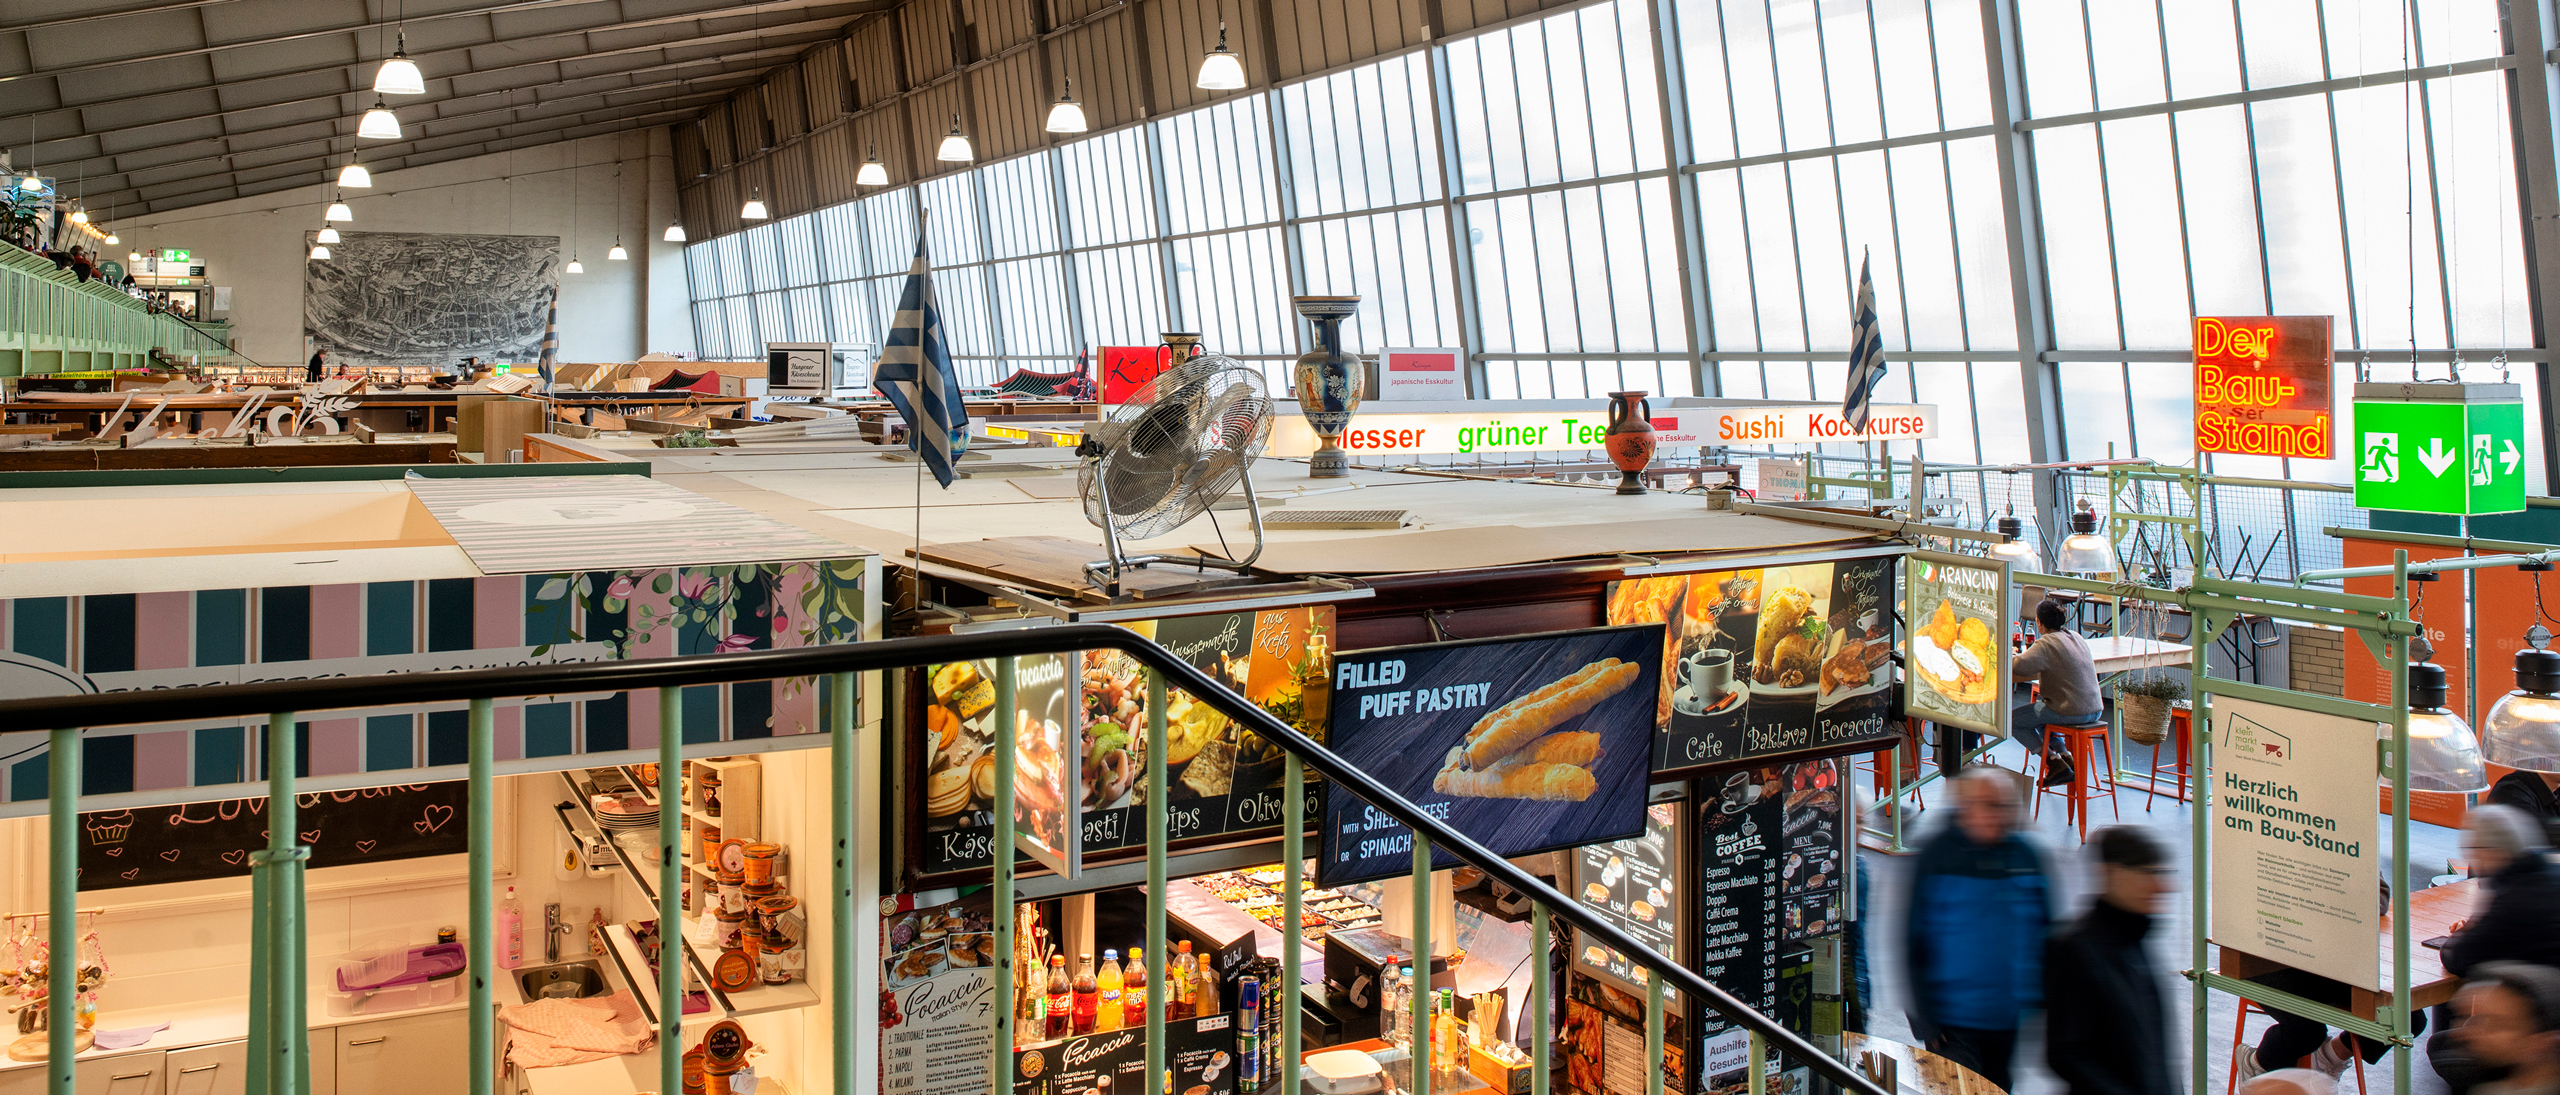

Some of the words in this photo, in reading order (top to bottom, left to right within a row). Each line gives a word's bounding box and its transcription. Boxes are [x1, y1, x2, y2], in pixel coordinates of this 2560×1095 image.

[2198, 318, 2273, 357] Der
[1391, 378, 1424, 386] japanische
[1425, 377, 1454, 385] Esskultur
[2199, 365, 2294, 406] Bau-
[1719, 415, 1783, 440] Sushi
[1809, 413, 1924, 437] Kockurse
[2198, 411, 2327, 457] Stand
[1458, 420, 1548, 453] grüner
[1562, 419, 1605, 444] Tee
[1940, 566, 1998, 591] ARANCINI
[1979, 600, 1997, 619] Spinac
[1263, 611, 1287, 630] aus
[1256, 623, 1293, 660] Kreta
[1336, 660, 1406, 690] FILLED
[1360, 691, 1411, 720] PUFF
[1416, 682, 1492, 713] PASTRY
[1748, 723, 1808, 750] Baklava
[1821, 713, 1884, 742] Focaccia
[2236, 726, 2252, 736] klein
[1686, 732, 1723, 760] Cafe
[2236, 736, 2257, 745] markt
[2236, 743, 2254, 753] halle
[2225, 771, 2298, 802] Herzlich
[1167, 805, 1200, 838] ips
[2225, 794, 2336, 831] willkommen
[1343, 823, 1359, 834] WITH
[1715, 832, 1739, 843] Best
[2225, 815, 2252, 832] am
[2261, 819, 2359, 858] Bau-Stand
[1341, 852, 1349, 862] OR
[1360, 834, 1411, 858] SPINACH
[1716, 834, 1762, 856] COFFEE
[1794, 835, 1813, 846] MENU
[1706, 867, 1730, 879] Espresso
[1764, 858, 1776, 870] 2,00
[1706, 881, 1730, 893] Espresso
[1731, 875, 1758, 888] Macchiato
[1764, 872, 1776, 883] 2,00
[1706, 894, 1727, 906] Doppio
[1764, 886, 1776, 897] 3,00
[1721, 907, 1738, 917] Crema
[1764, 900, 1776, 911] 2,00
[1706, 920, 1738, 935] Cappuccino
[1764, 913, 1776, 925] 2,40
[1706, 936, 1720, 948] Latte
[1721, 932, 1749, 945] Macchiato
[1764, 927, 1776, 938] 2,40
[1706, 951, 1724, 962] Mokka
[1725, 947, 1742, 959] Kaffee
[1763, 941, 1775, 952] 3,00
[1706, 965, 1725, 977] Frappe
[1763, 955, 1775, 966] 4,50
[1763, 968, 1775, 980] 3,50
[1763, 982, 1775, 994] 3,00
[931, 1011, 950, 1022] Italian
[950, 1001, 968, 1013] Style
[1763, 996, 1775, 1007] 2,50
[894, 1030, 924, 1043] TRADITIONALE
[1705, 1020, 1725, 1032] Wasser
[889, 1049, 893, 1059] 2.
[895, 1047, 912, 1058] PARMA
[1062, 1031, 1135, 1071] Focaccia
[1710, 1039, 1747, 1057] Aushilfe
[889, 1064, 893, 1074] 3.
[895, 1062, 913, 1073] NAPOLI
[1710, 1054, 1747, 1071] Gesucht
[889, 1079, 893, 1089] 4.
[895, 1076, 914, 1088] MILANO
